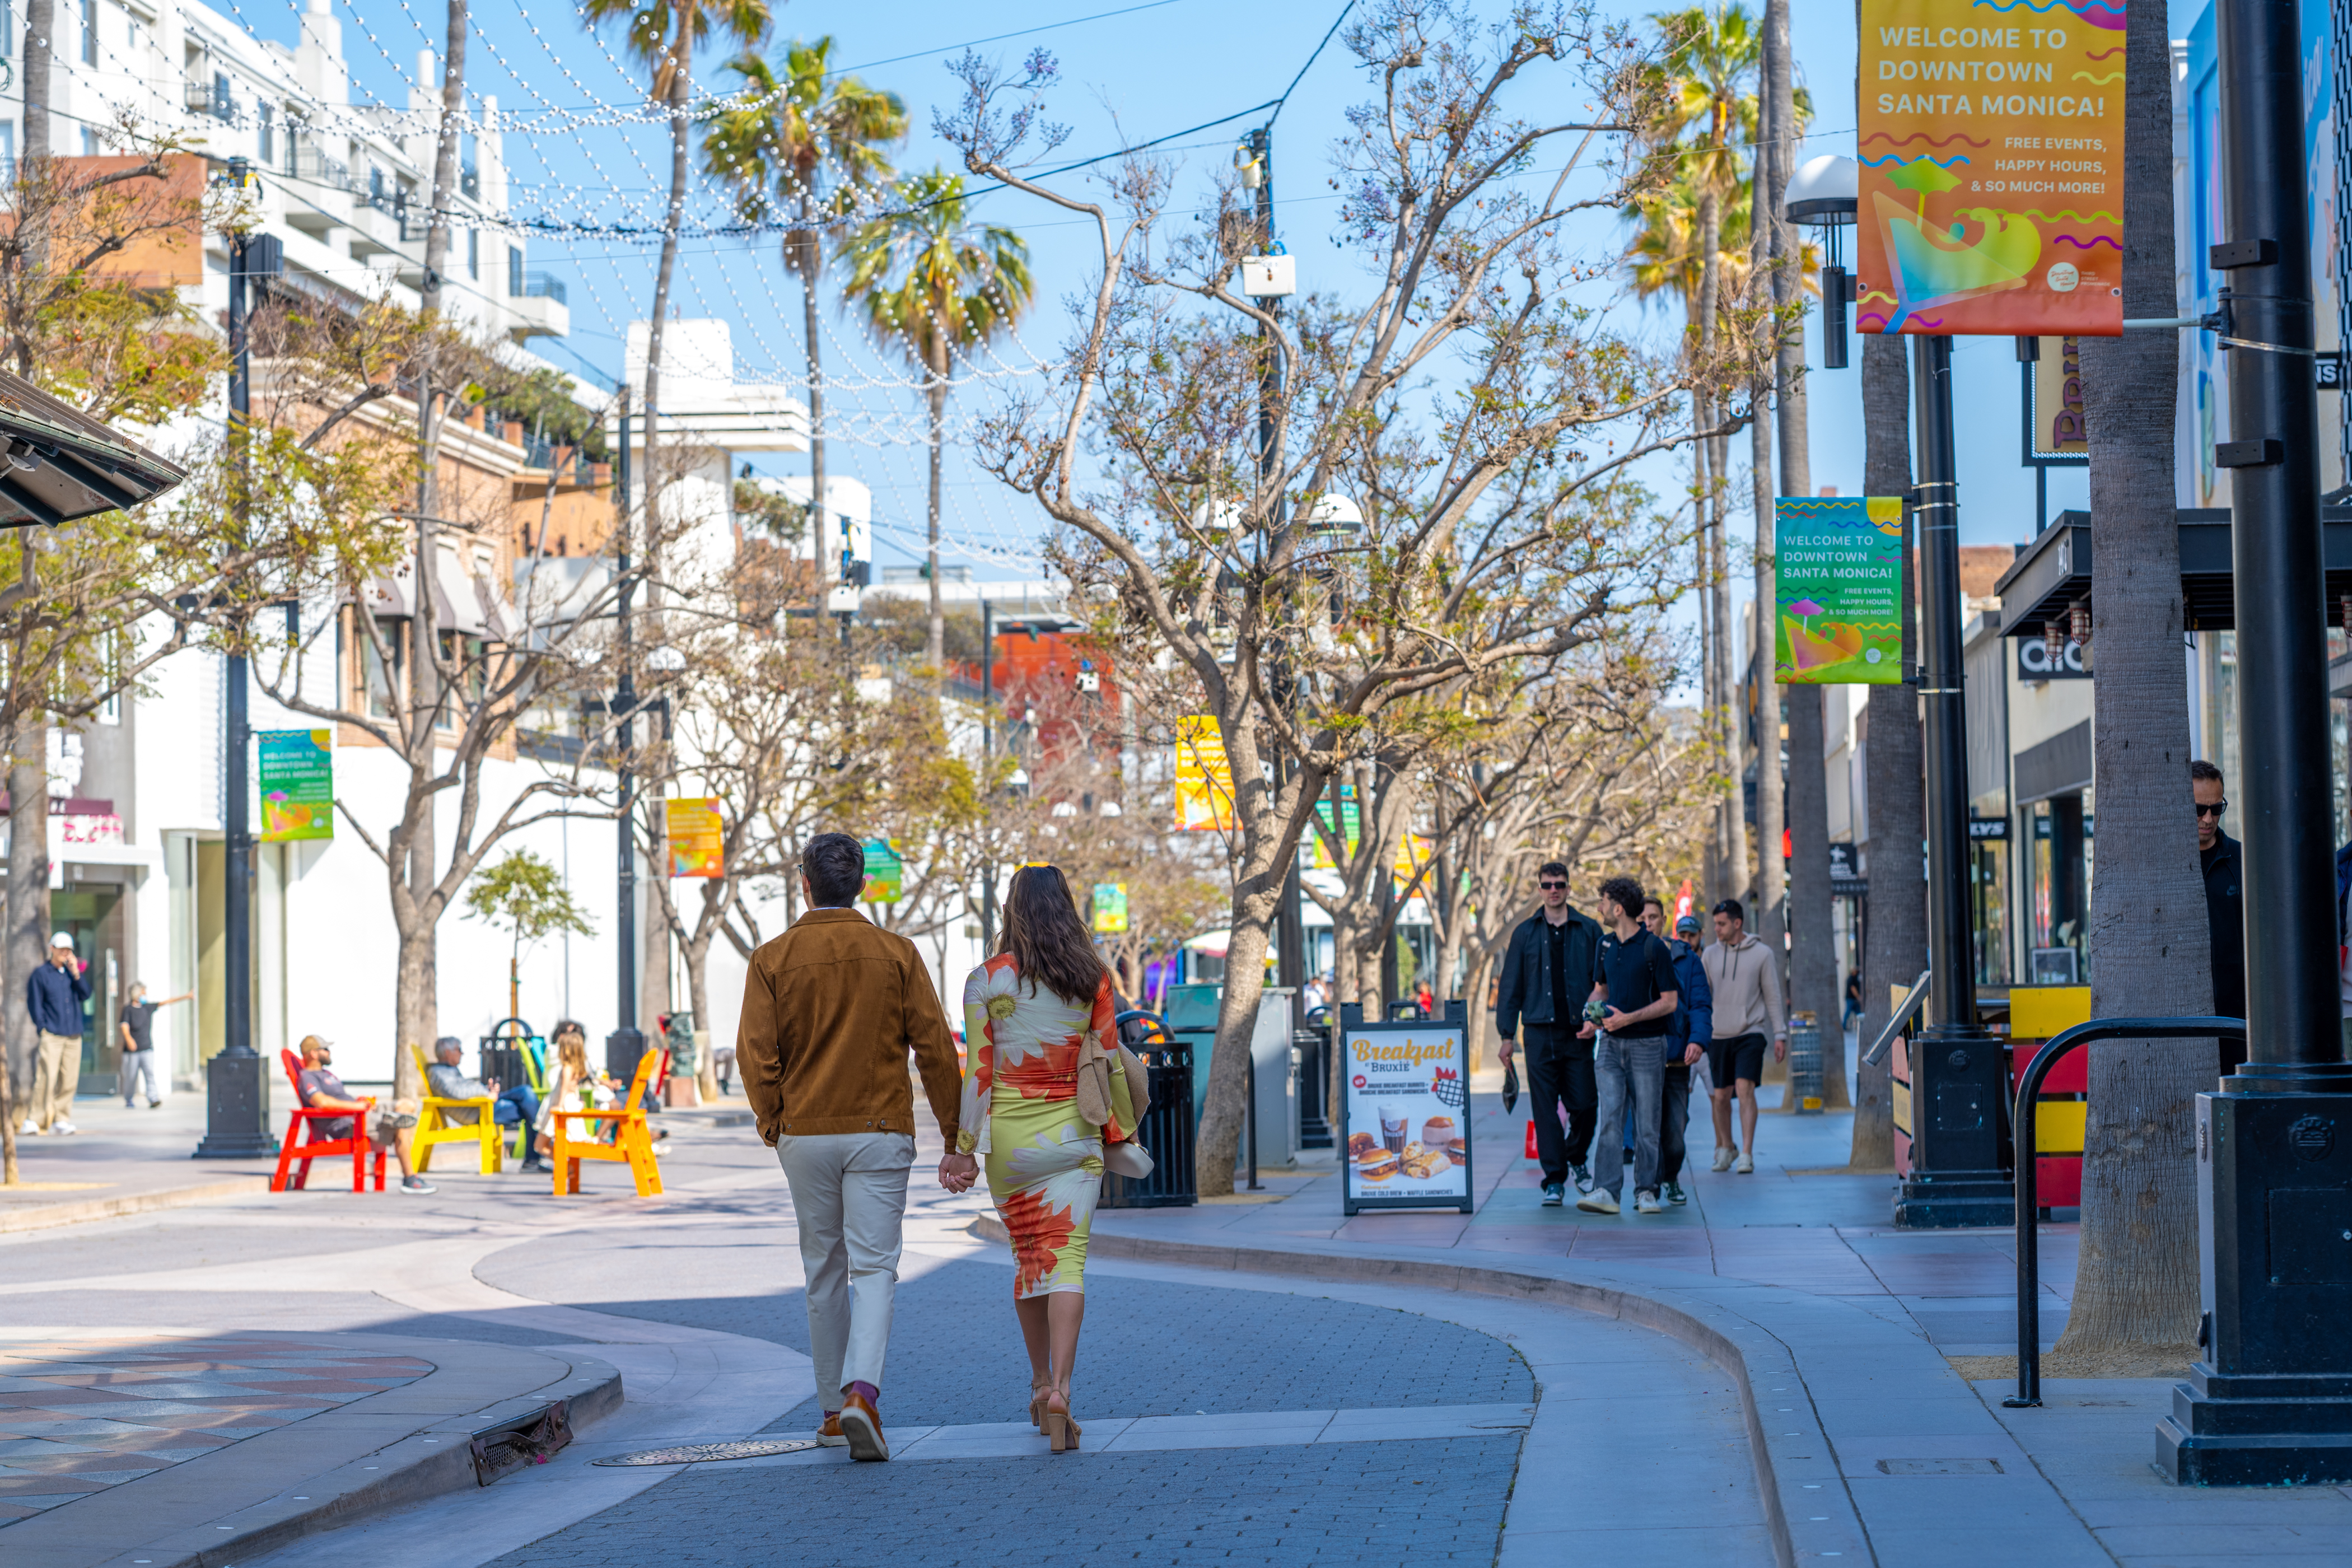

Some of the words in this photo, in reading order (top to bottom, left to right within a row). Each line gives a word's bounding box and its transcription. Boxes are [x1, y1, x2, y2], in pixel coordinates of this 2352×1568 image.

[1879, 26, 2020, 48] WELCOME
[2029, 29, 2067, 49] TO
[1879, 60, 2052, 83] DOWNTOWN
[1878, 93, 1972, 114] SANTA
[1982, 95, 2104, 117] MONICA!
[2005, 137, 2041, 148] FREE
[2045, 138, 2107, 153] EVENTS,
[1995, 160, 2046, 171] HAPPY
[2050, 160, 2107, 175] HOURS,
[1971, 181, 1981, 192] &
[1986, 181, 2006, 192] SO
[2009, 181, 2055, 193] MUCH
[2058, 182, 2105, 194] MORE!
[1784, 535, 1851, 546] WELCOME
[1856, 536, 1874, 546] TO
[1784, 552, 1868, 562] DOWNTOWN
[1784, 568, 1830, 578] SANTA
[1833, 568, 1893, 578] MONICA!
[263, 752, 302, 760] WELCOME
[263, 761, 314, 771] DOWNTOWN
[263, 771, 291, 780] SANTA
[1352, 1038, 1455, 1067] Breakfast
